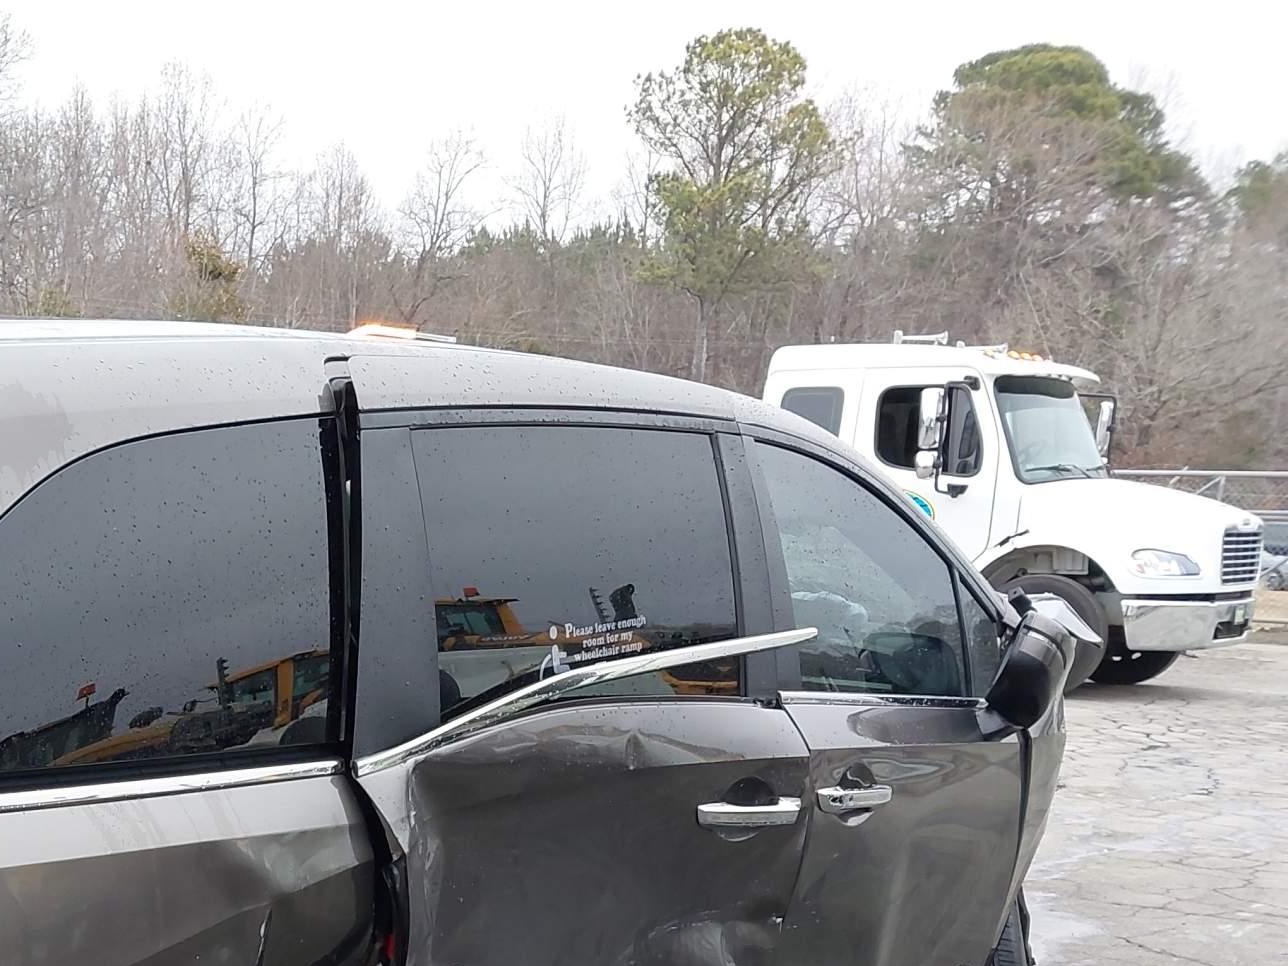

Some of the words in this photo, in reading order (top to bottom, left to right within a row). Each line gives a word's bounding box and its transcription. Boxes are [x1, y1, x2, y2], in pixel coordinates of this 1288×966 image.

[564, 622, 593, 639] Please
[594, 621, 616, 634] leave
[617, 614, 647, 630] enough
[582, 635, 605, 649] room
[606, 633, 619, 644] for
[620, 631, 634, 642] my
[574, 644, 620, 662] wheelchair
[621, 641, 643, 653] ramp
